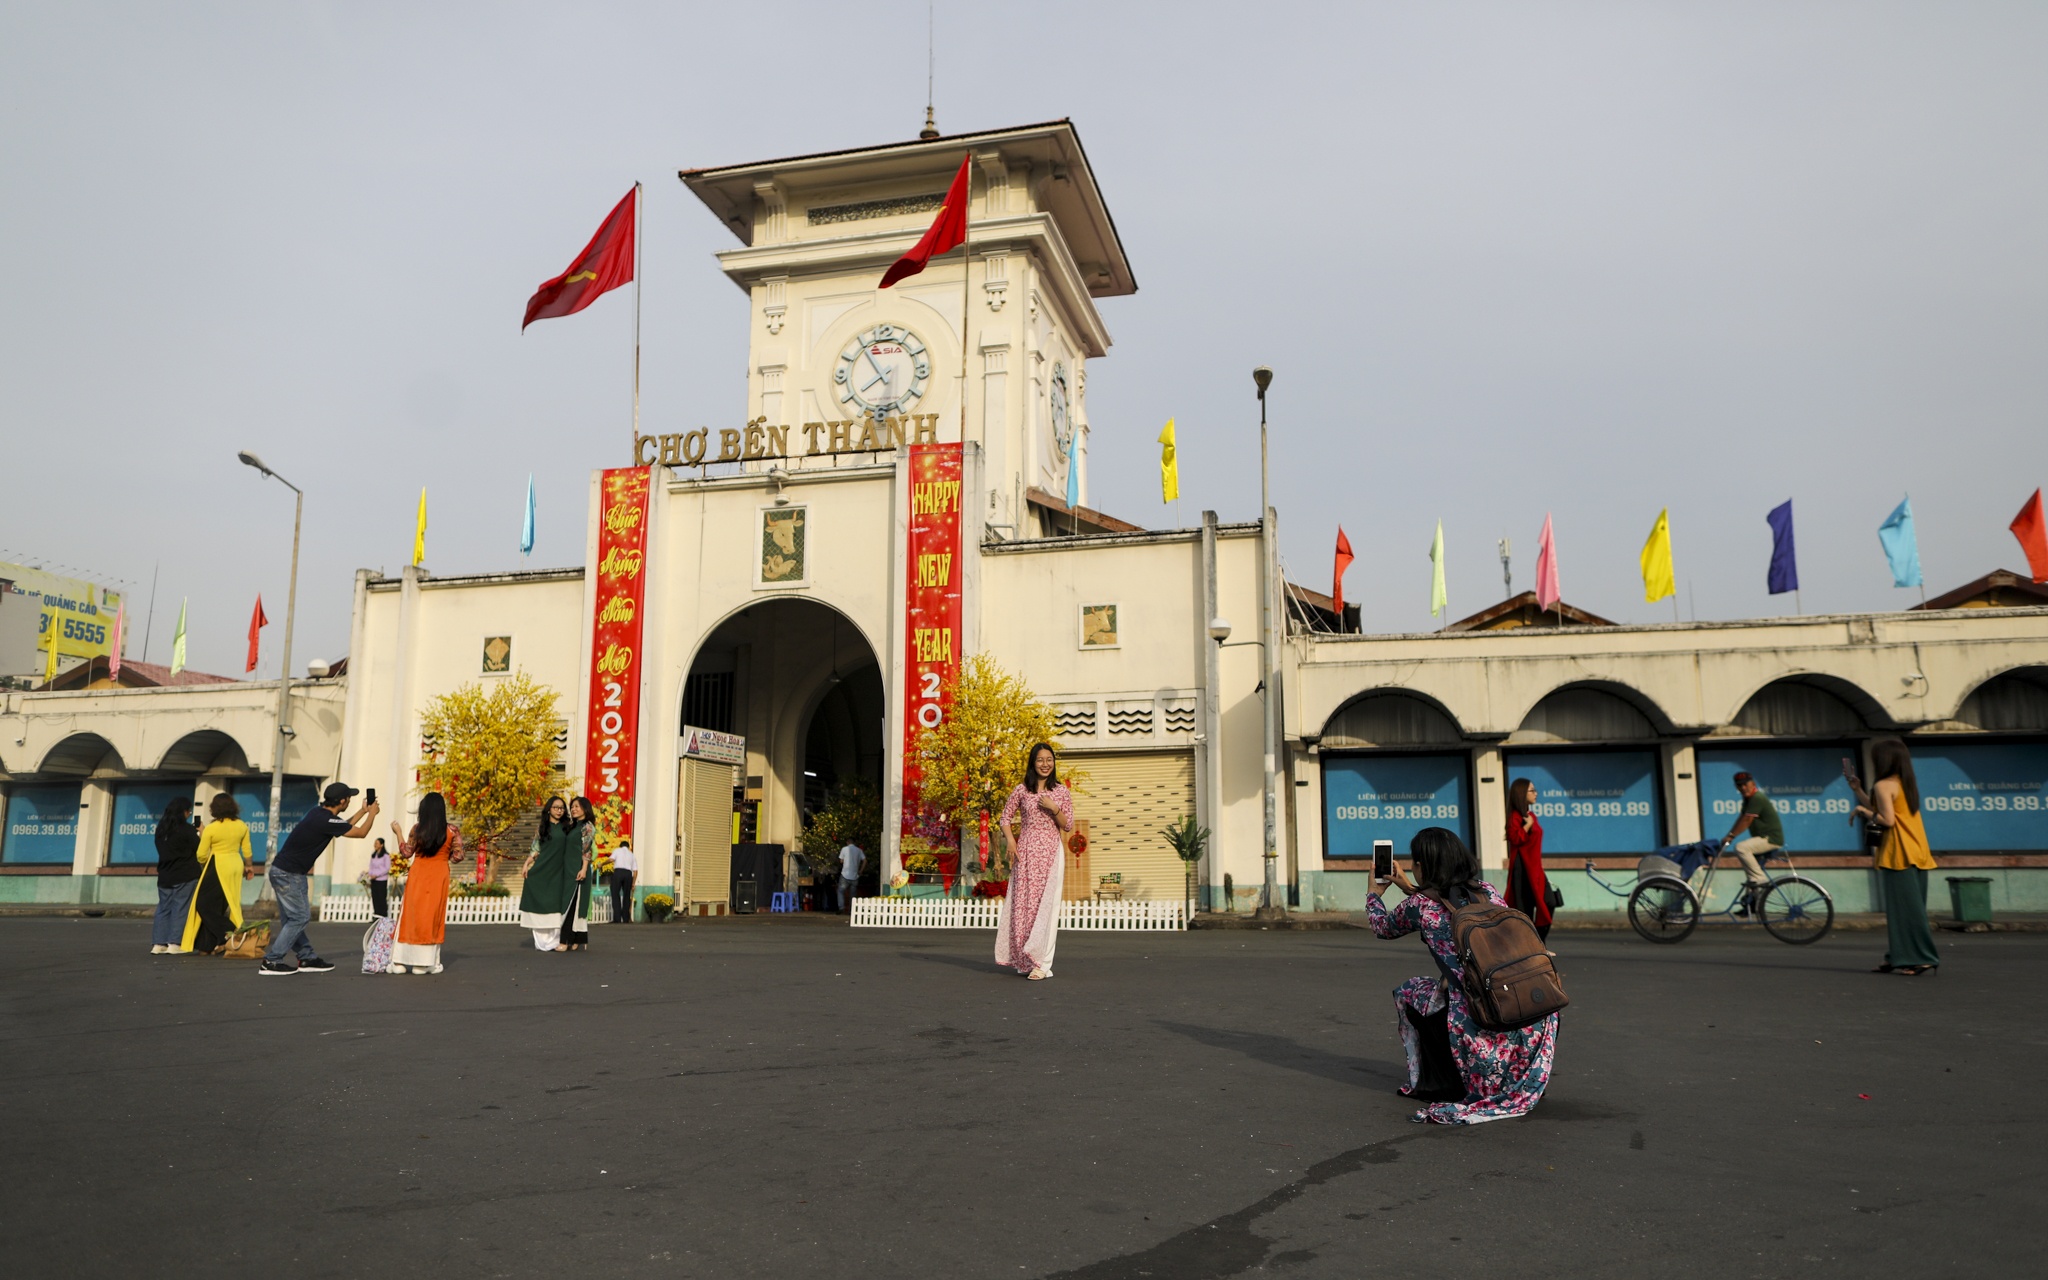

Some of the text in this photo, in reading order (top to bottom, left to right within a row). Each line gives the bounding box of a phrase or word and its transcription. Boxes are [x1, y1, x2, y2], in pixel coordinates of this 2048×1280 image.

[872, 325, 893, 342] 12
[834, 362, 929, 385] 9 3
[874, 405, 888, 422] 6
[635, 411, 939, 468] CHỢ BẾN THÀNH
[914, 480, 960, 515] HAPPY
[606, 504, 641, 534] Chúc
[600, 546, 642, 580] Mừng
[918, 553, 951, 588] NEW
[43, 594, 77, 611] QUẢNG
[80, 602, 97, 616] CÁO
[600, 596, 635, 624] Năm
[64, 618, 105, 645] 5555
[597, 645, 632, 676] Mới
[914, 628, 953, 665] YEAR
[600, 682, 622, 793] 2023
[1358, 793, 1376, 801] LIÊN
[1336, 805, 1459, 820] 0969.39.89.89
